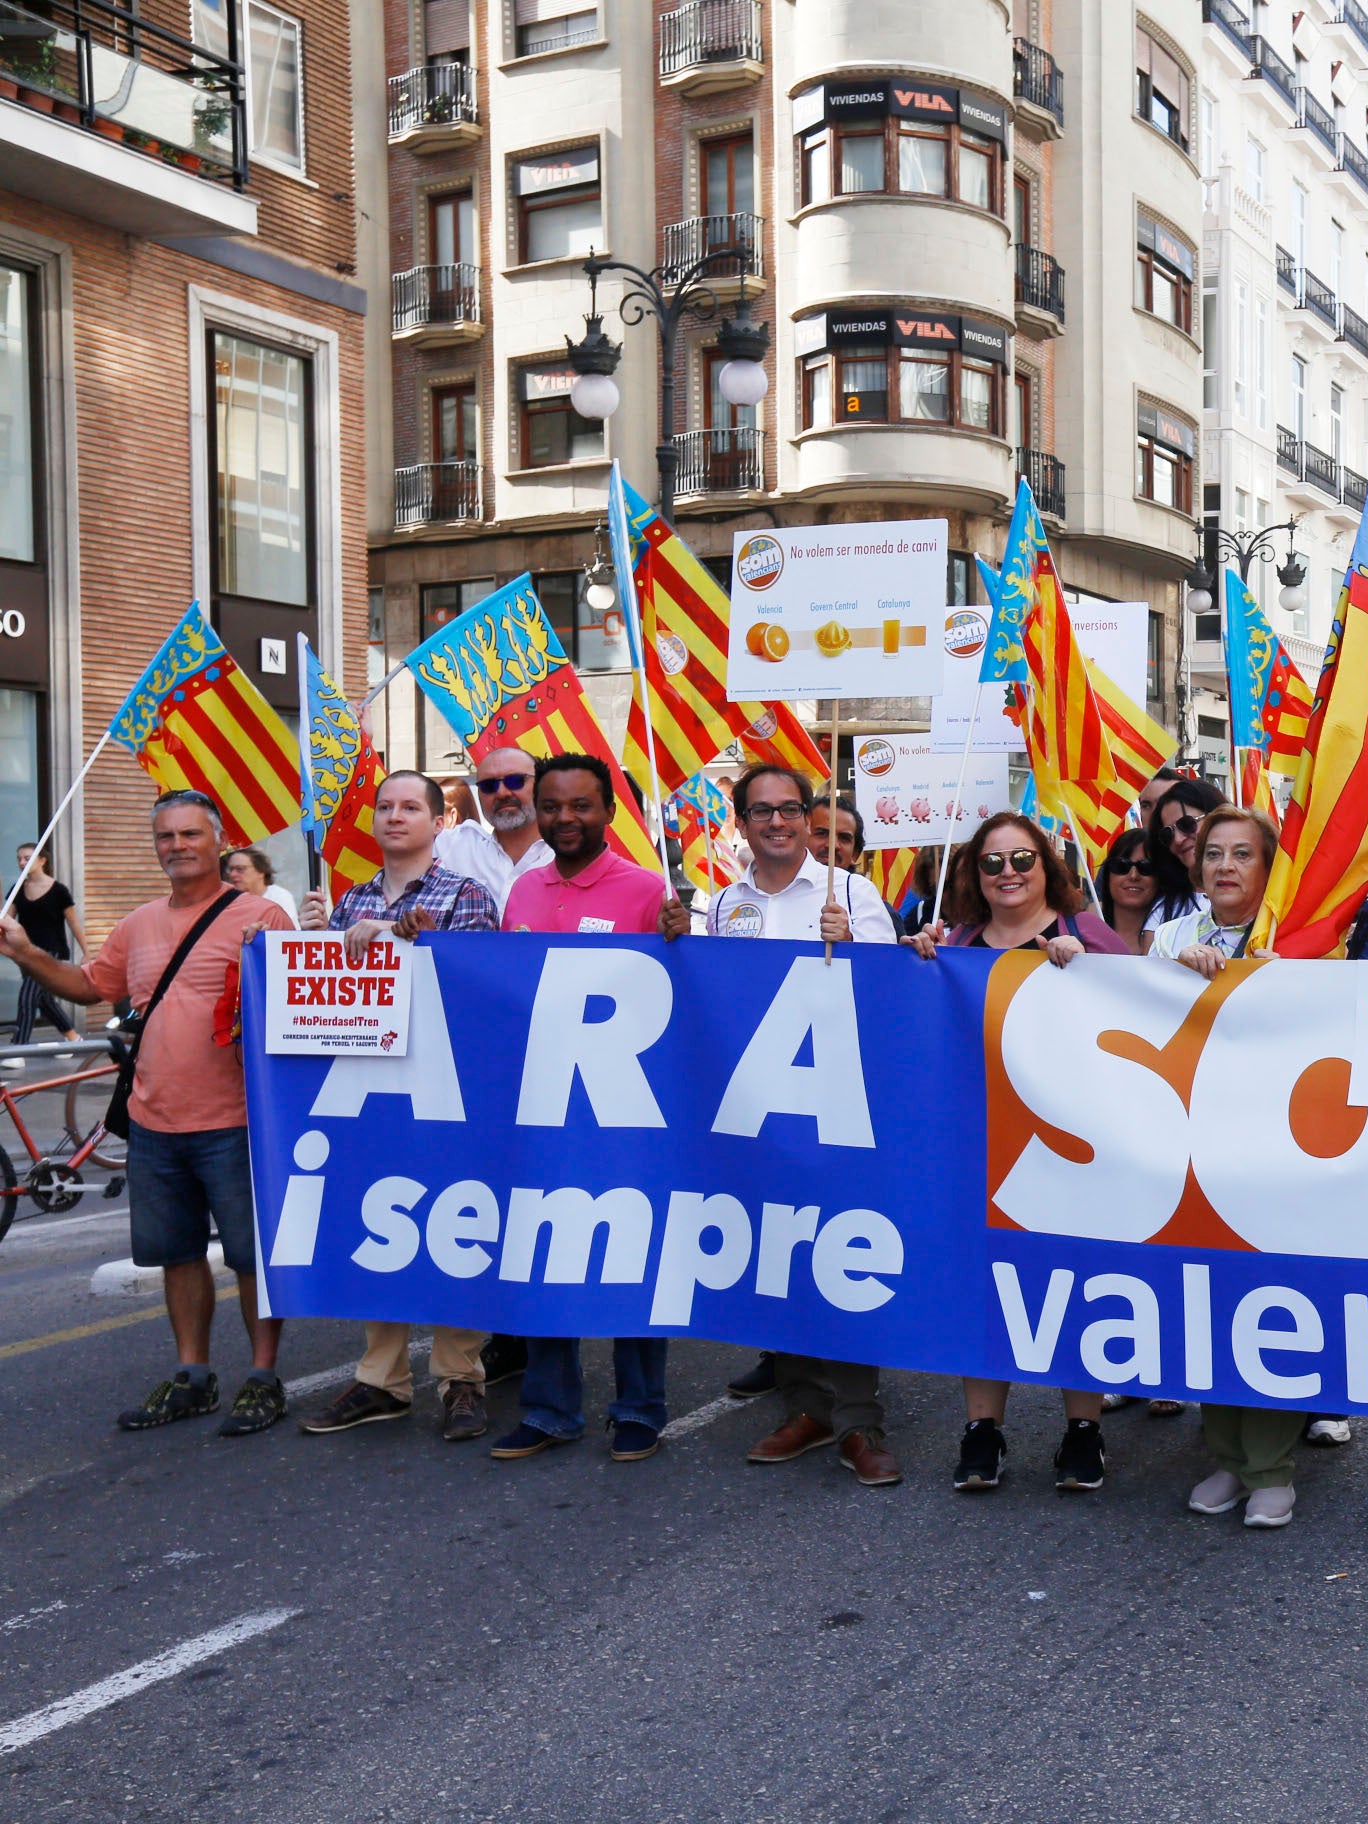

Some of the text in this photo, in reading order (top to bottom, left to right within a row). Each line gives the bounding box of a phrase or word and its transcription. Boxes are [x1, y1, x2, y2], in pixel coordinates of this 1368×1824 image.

[830, 90, 1001, 127] VIVIENDAS VILA VIVIENDAS
[832, 319, 1002, 349] VIVIENDAS VILA VIVIENDAS
[790, 538, 938, 559] No volem ser moneda de canvi
[757, 599, 911, 615] Valencia Govern Central Catalunya
[900, 746, 910, 755] No
[287, 976, 395, 1006] EXISTE
[293, 1016, 379, 1027] #NoPierdaselTren
[309, 945, 876, 1149] ARA
[270, 1130, 904, 1326] i sempre
